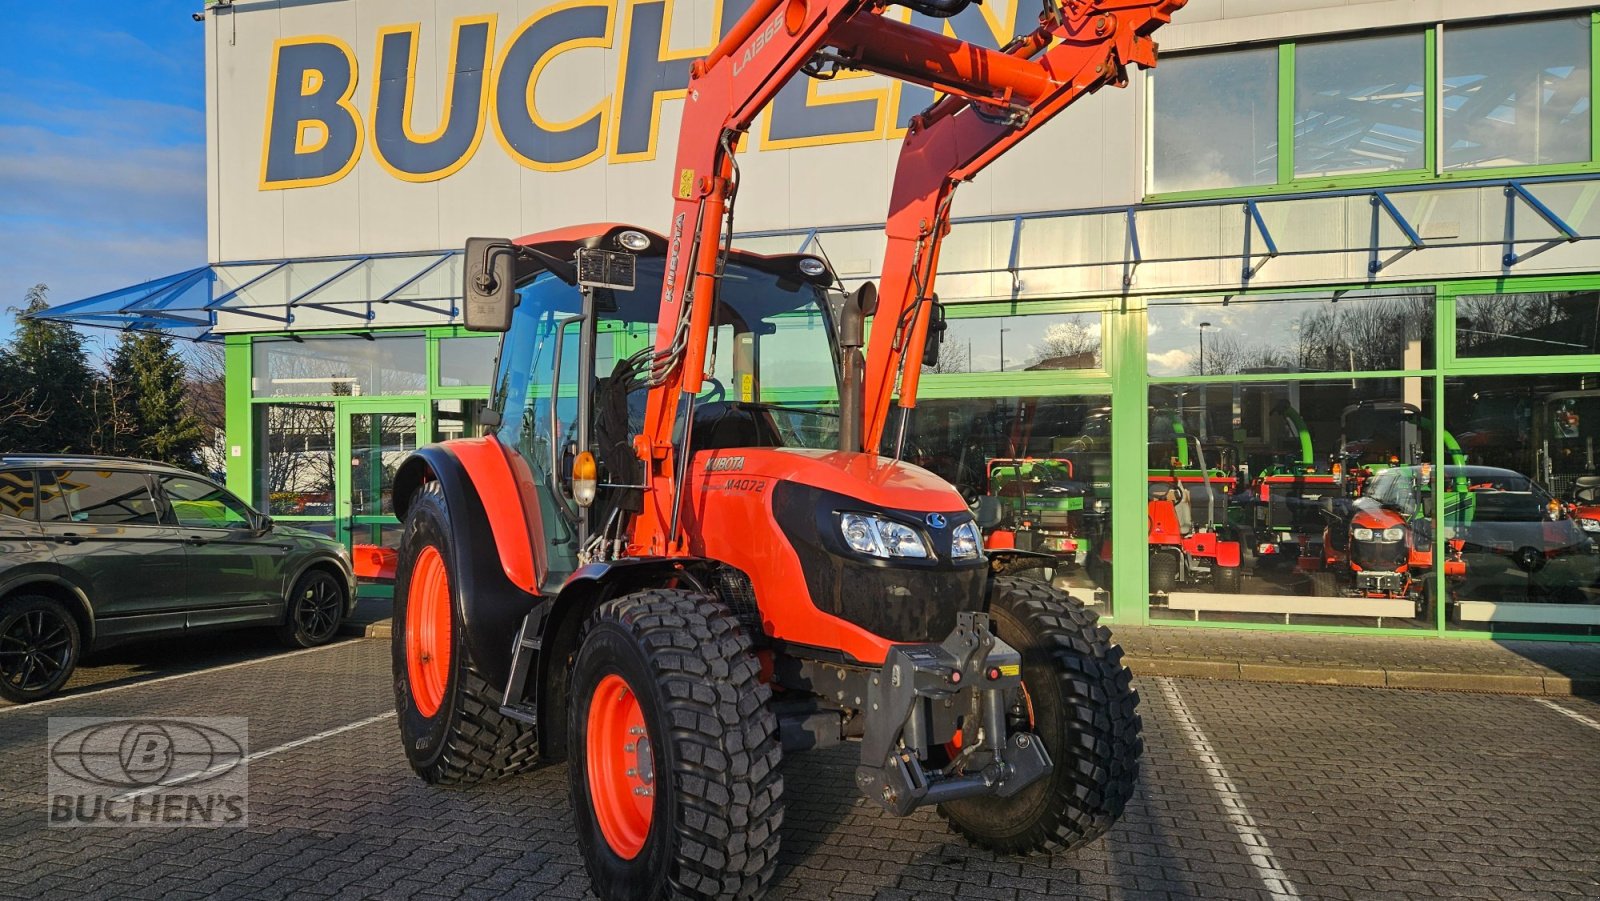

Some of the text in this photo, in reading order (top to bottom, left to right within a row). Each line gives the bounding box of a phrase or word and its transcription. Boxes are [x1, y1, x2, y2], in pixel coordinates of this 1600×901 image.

[732, 10, 785, 77] LA1365
[664, 212, 686, 304] KUBOTA
[705, 456, 746, 472] KUBOTA
[725, 479, 766, 493] M4072
